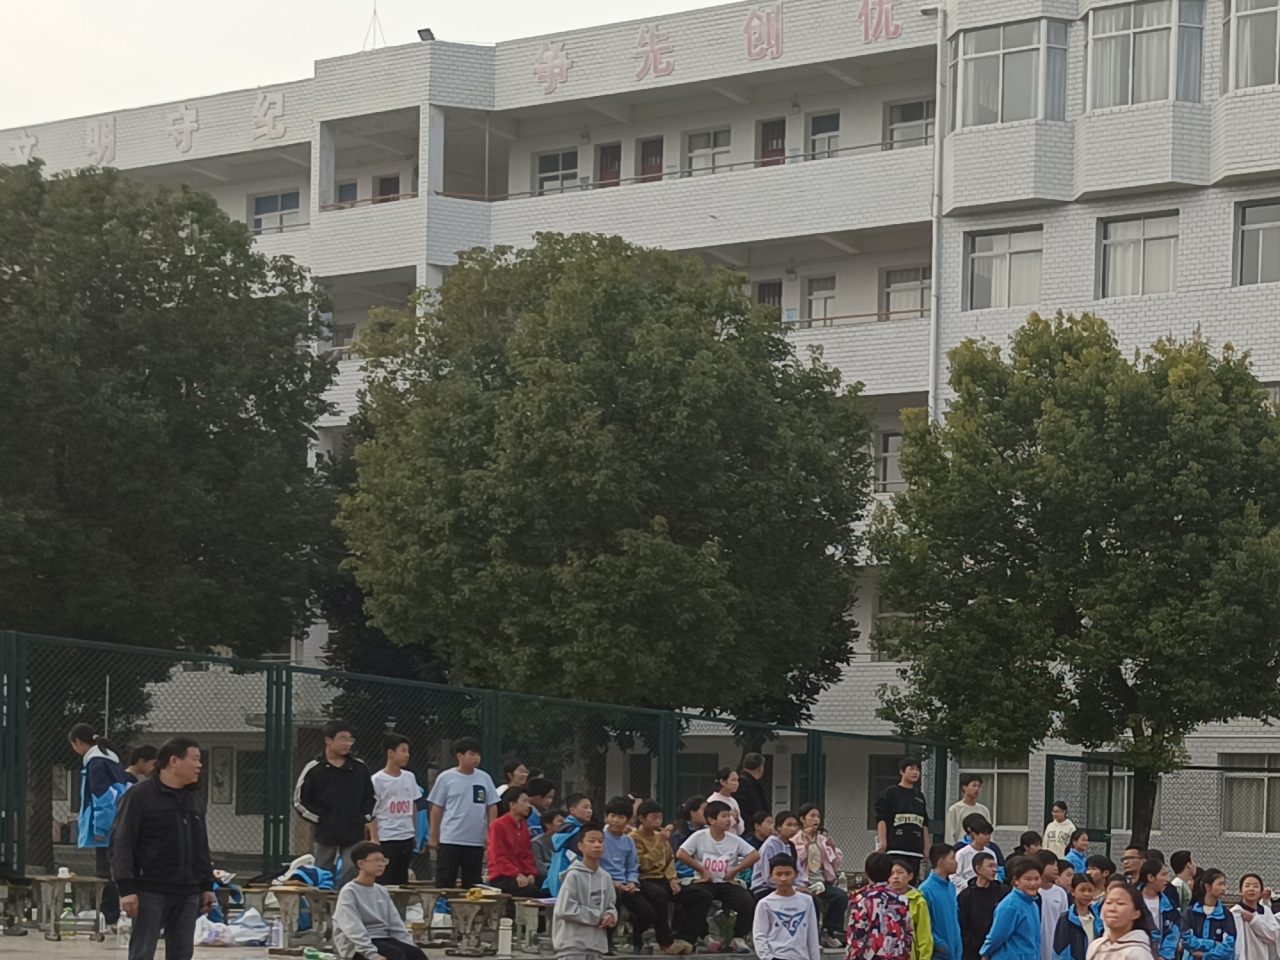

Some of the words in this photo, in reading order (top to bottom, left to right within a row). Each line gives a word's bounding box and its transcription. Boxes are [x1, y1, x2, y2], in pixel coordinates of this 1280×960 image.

[533, 0, 903, 95] 争先创优
[9, 91, 288, 165] 文明守纪
